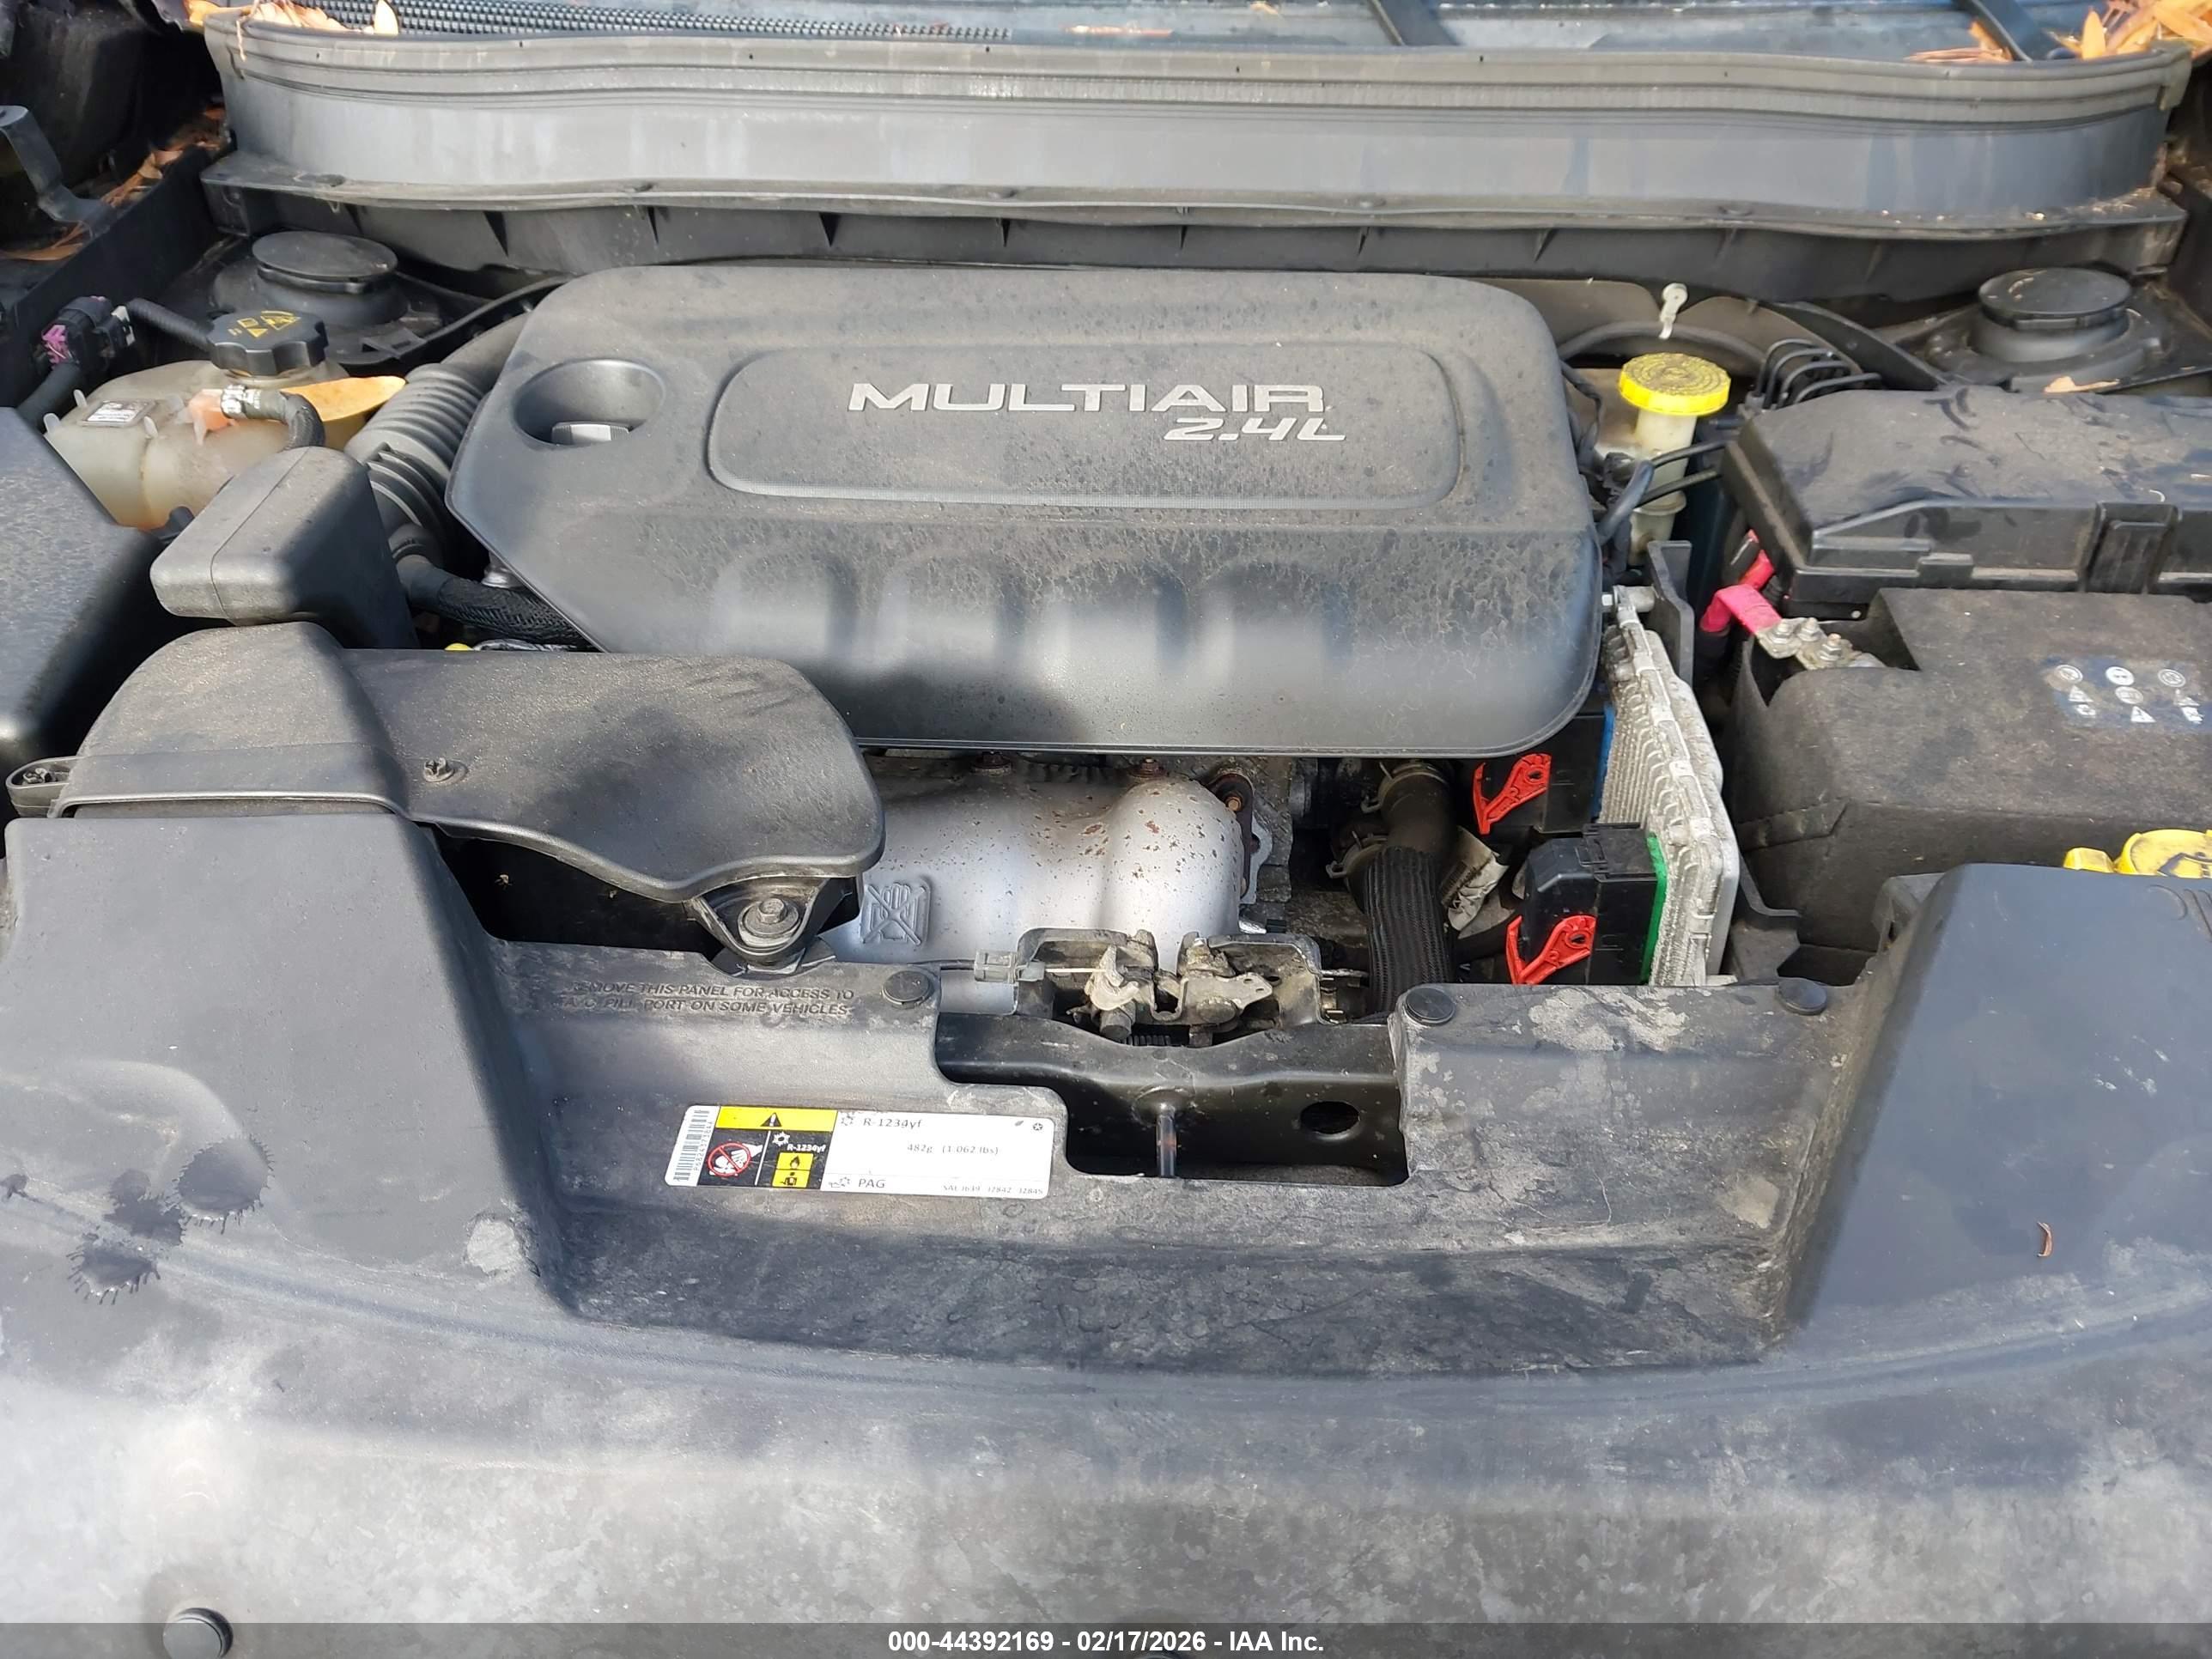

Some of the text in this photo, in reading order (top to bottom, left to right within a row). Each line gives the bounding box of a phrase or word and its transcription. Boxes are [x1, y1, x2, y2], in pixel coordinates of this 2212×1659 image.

[846, 383, 1328, 412] MULTIAIR
[1164, 417, 1346, 441] 2.4L
[570, 981, 854, 1000] REMOVE THIS PANEL FOR ACCESS TO
[643, 999, 686, 1010] PORT
[690, 1000, 715, 1011] ON
[719, 1001, 767, 1013] SOME
[771, 1003, 848, 1015] VEHICLES
[907, 1143, 933, 1154] 482g
[859, 1178, 886, 1188] PAG
